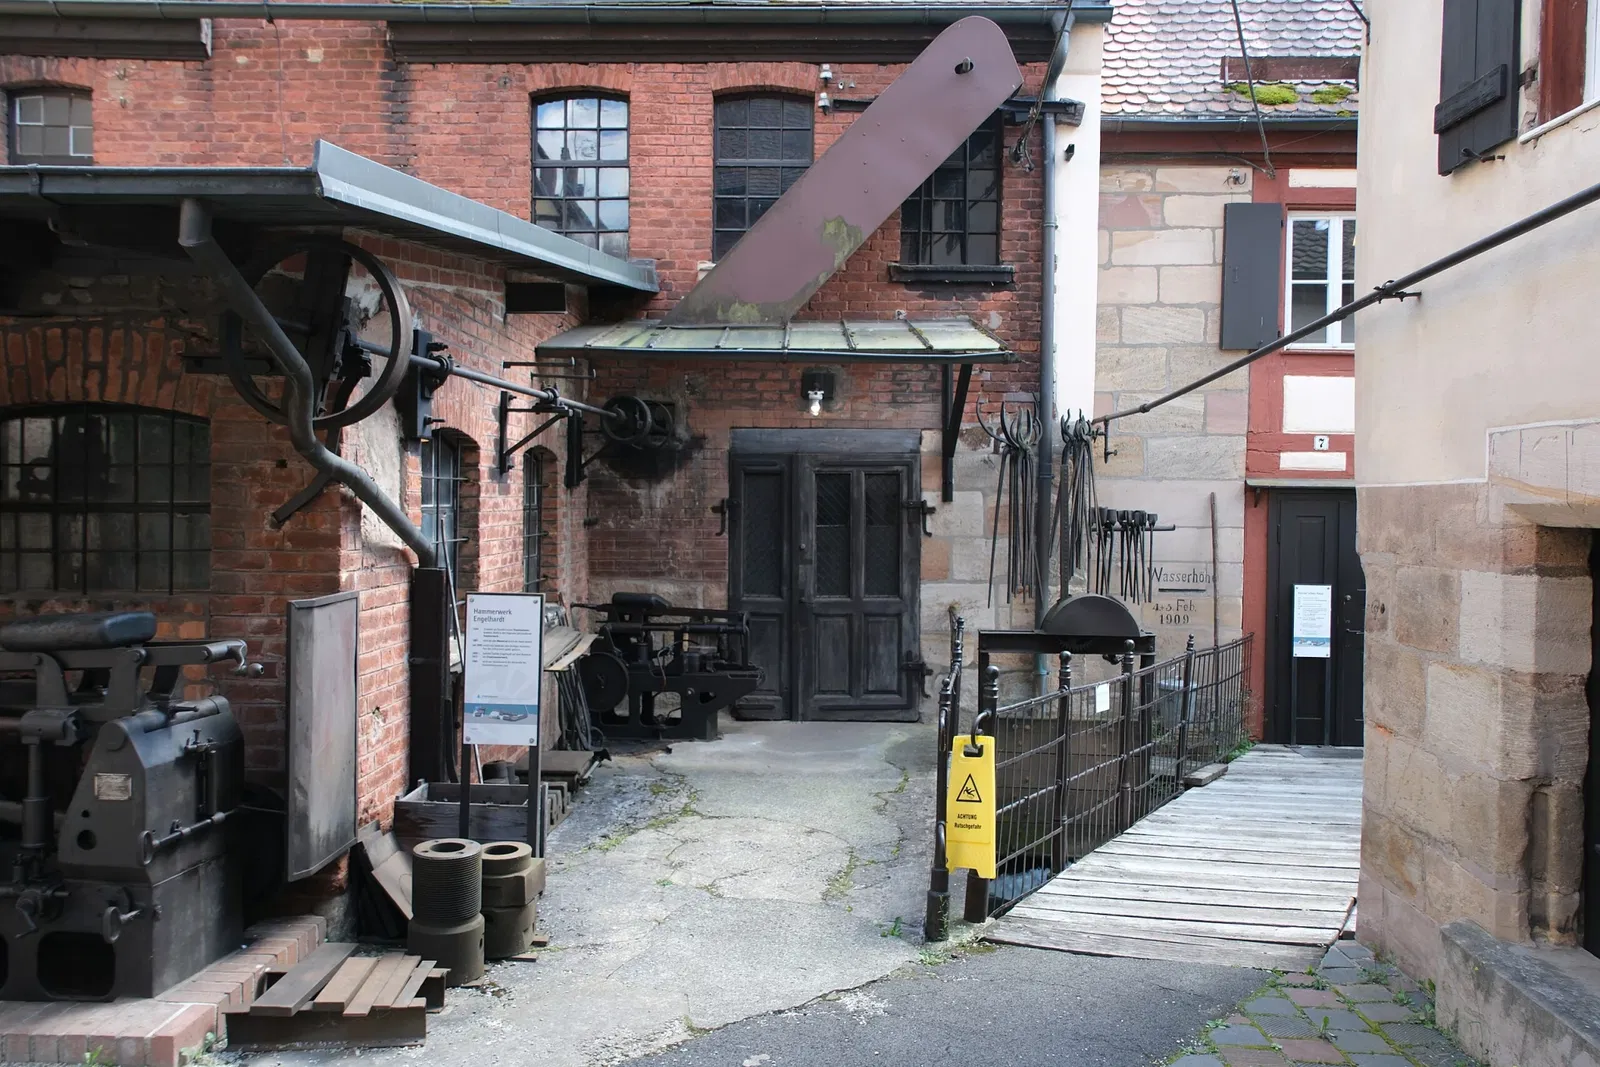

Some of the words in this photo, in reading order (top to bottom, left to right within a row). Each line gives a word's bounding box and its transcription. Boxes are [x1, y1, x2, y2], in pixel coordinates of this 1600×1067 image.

[1319, 438, 1325, 448] 7
[1147, 567, 1217, 584] Wasserhöh
[1176, 599, 1197, 612] Feb.
[473, 615, 505, 624] Engelhardt
[1160, 614, 1189, 625] 1909
[954, 822, 982, 830] Rutschgefahr
